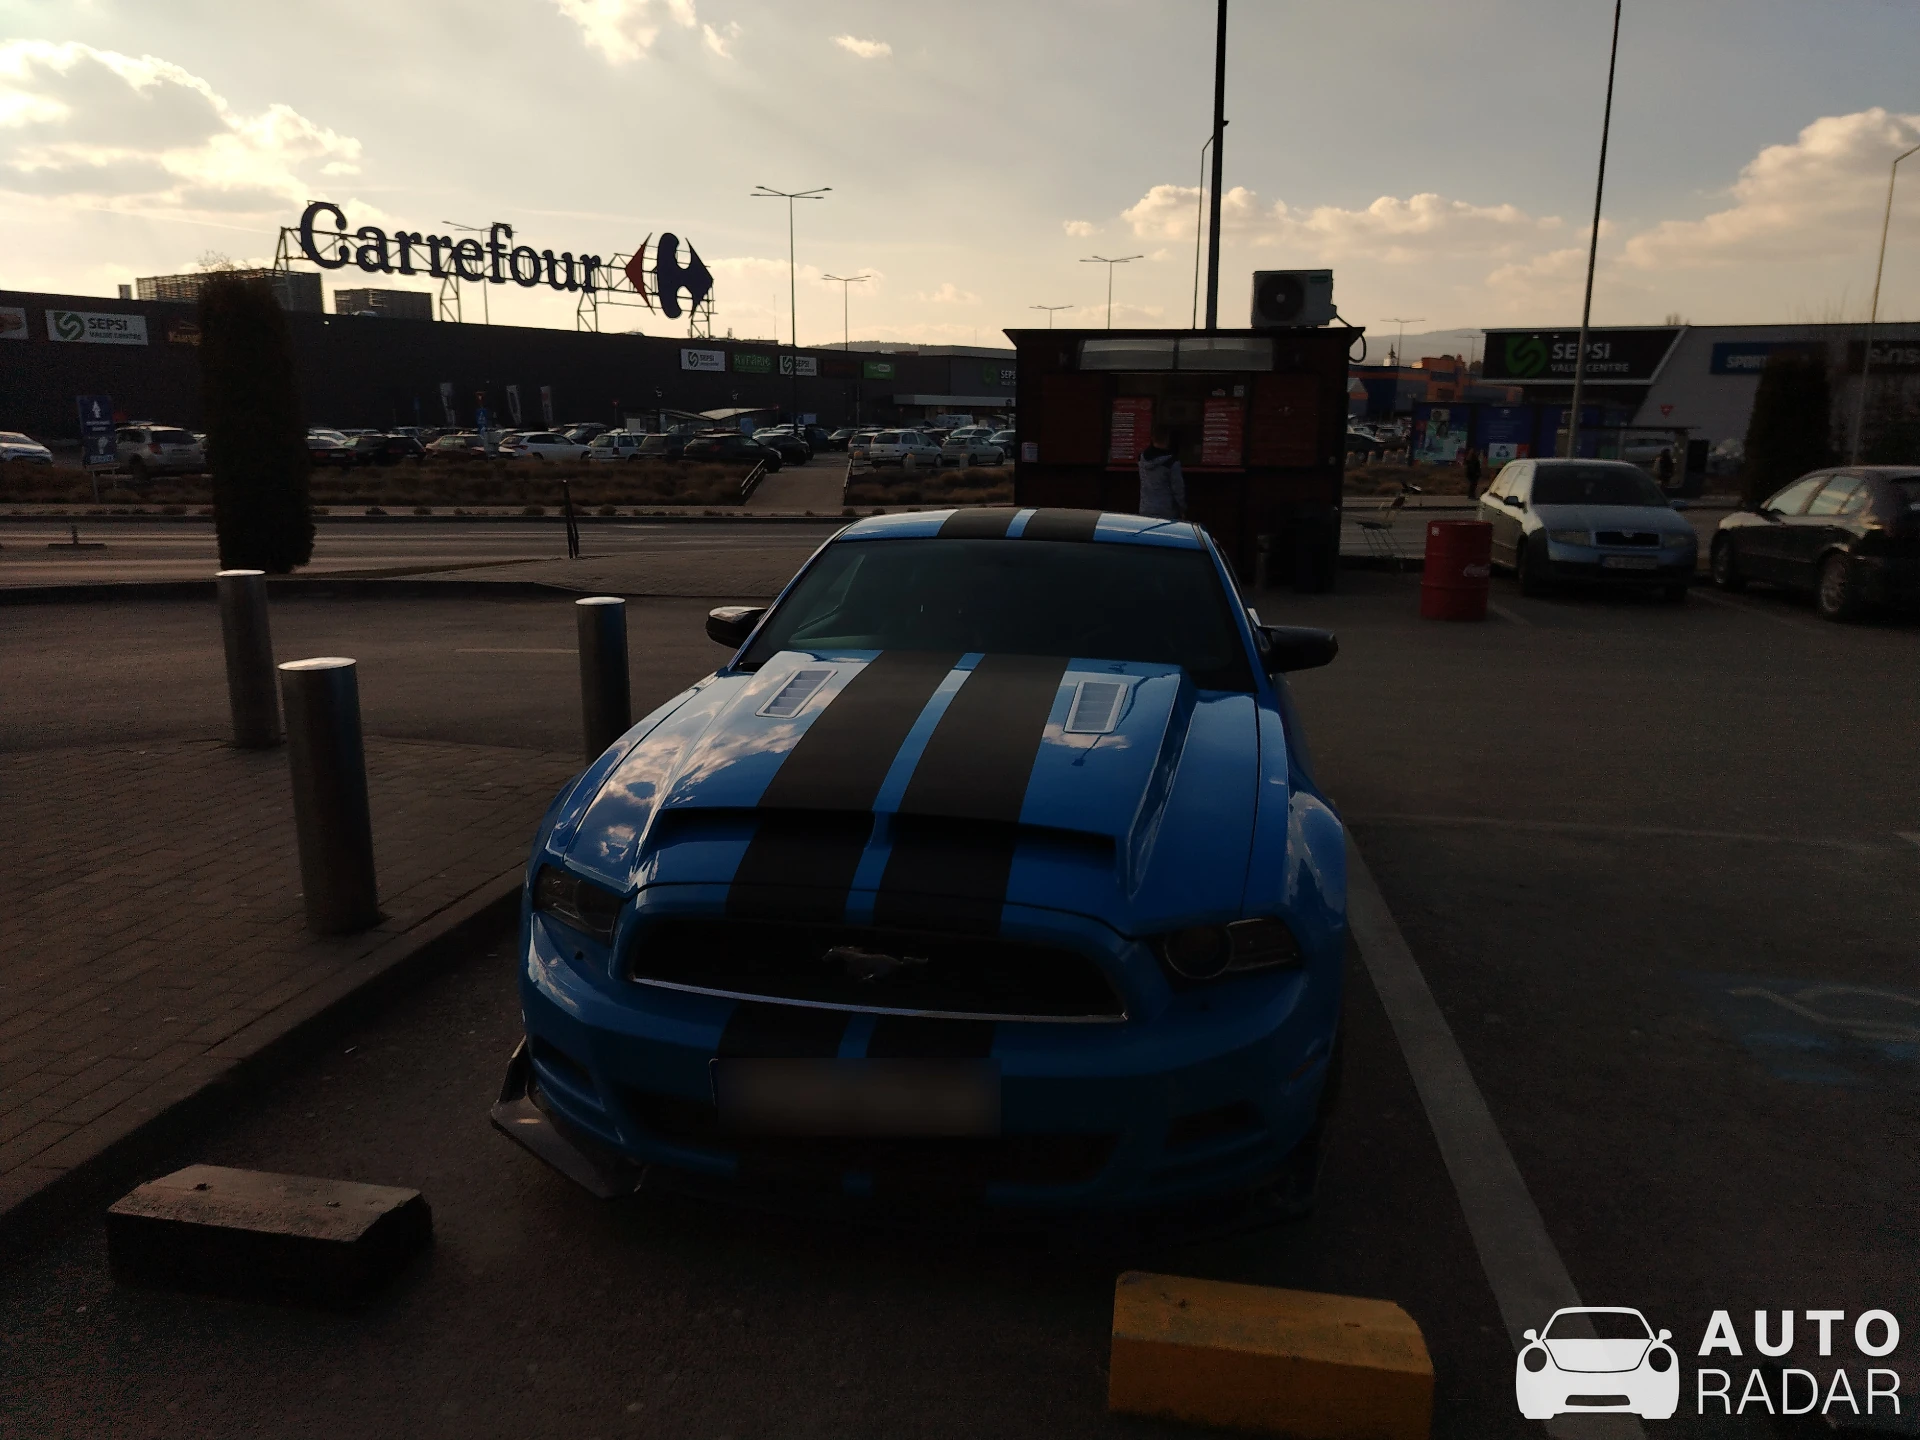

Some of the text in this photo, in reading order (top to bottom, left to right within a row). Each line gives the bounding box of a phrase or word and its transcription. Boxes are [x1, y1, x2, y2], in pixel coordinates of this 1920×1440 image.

[300, 201, 601, 293] Carrefour
[87, 317, 128, 331] SEPSI
[1550, 363, 1630, 373] VALU CENTRE
